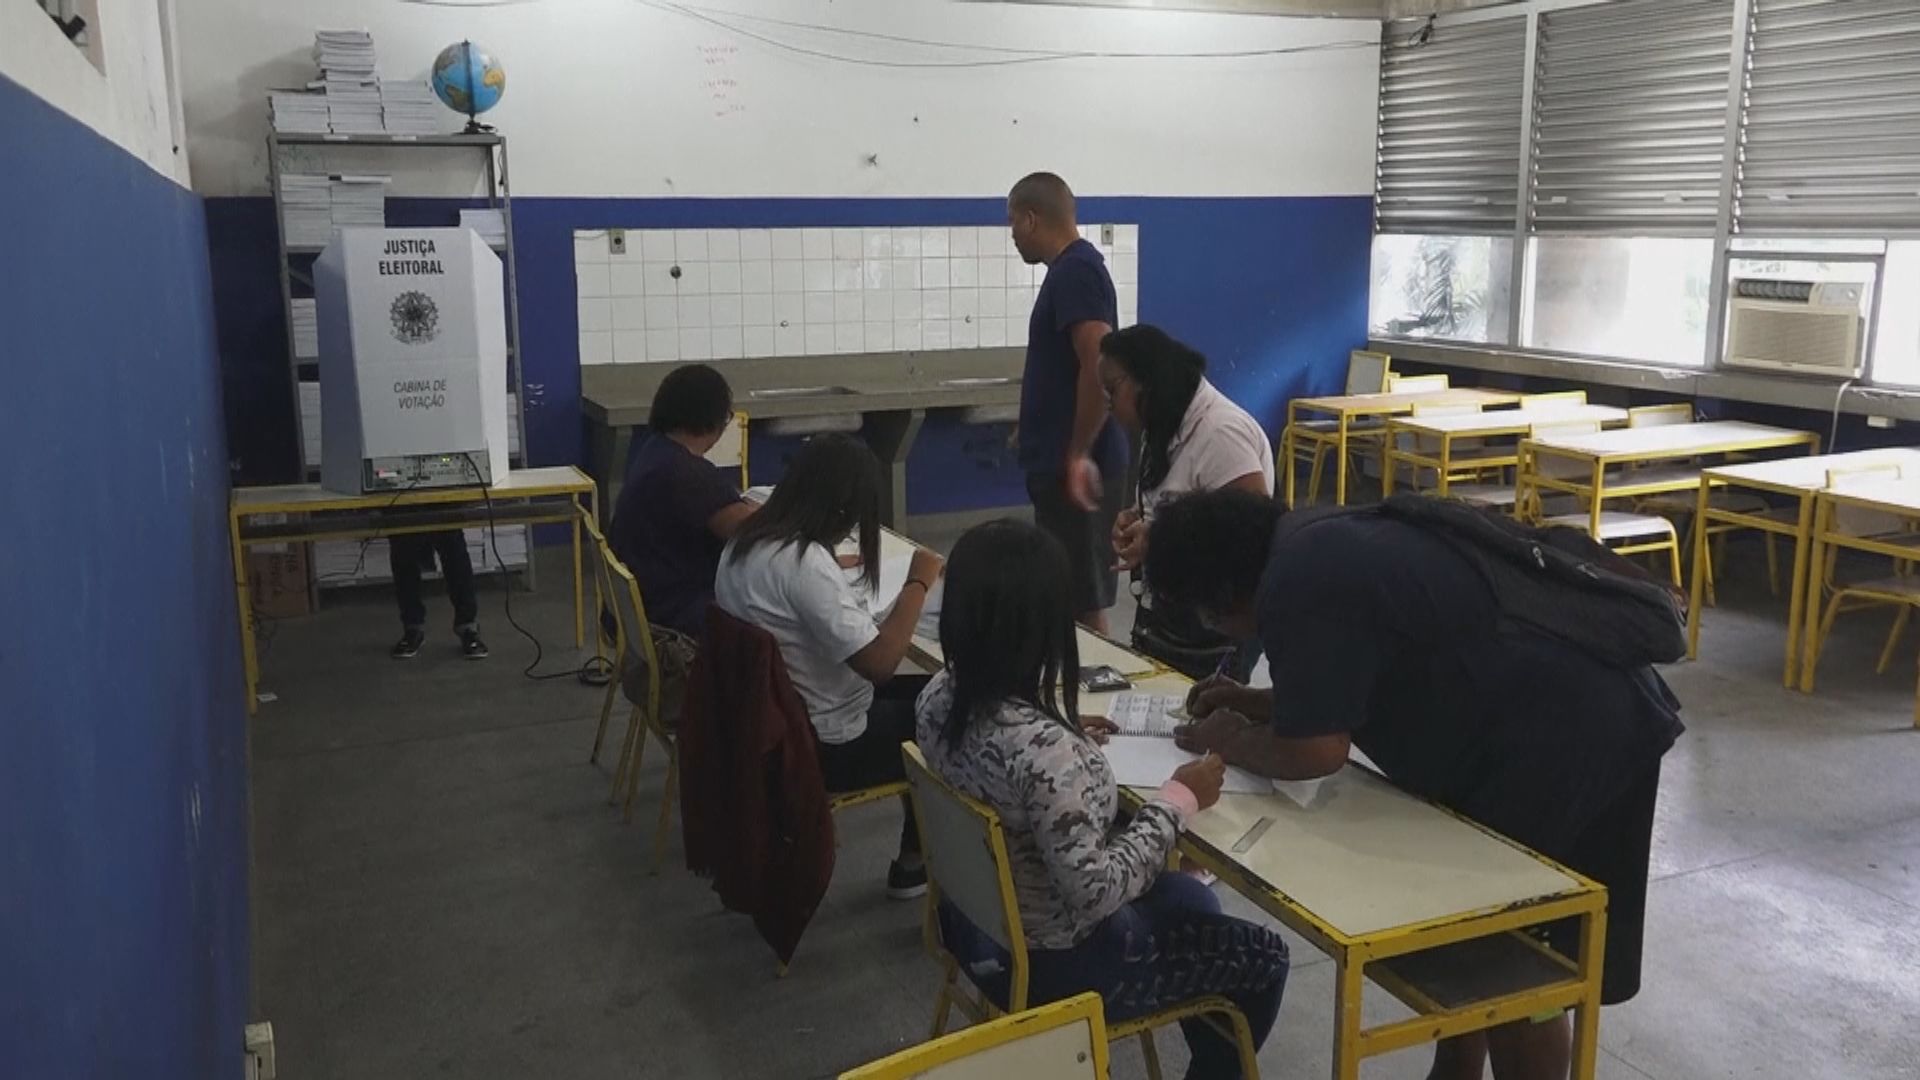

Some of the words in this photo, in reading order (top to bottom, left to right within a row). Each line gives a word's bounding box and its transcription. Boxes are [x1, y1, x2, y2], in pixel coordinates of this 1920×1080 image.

[384, 239, 436, 257] JUSTIÇA
[379, 260, 445, 276] ELEITORAL
[394, 381, 431, 393] CABINA
[433, 379, 447, 392] DE
[399, 393, 446, 410] VOTAÇÃO
